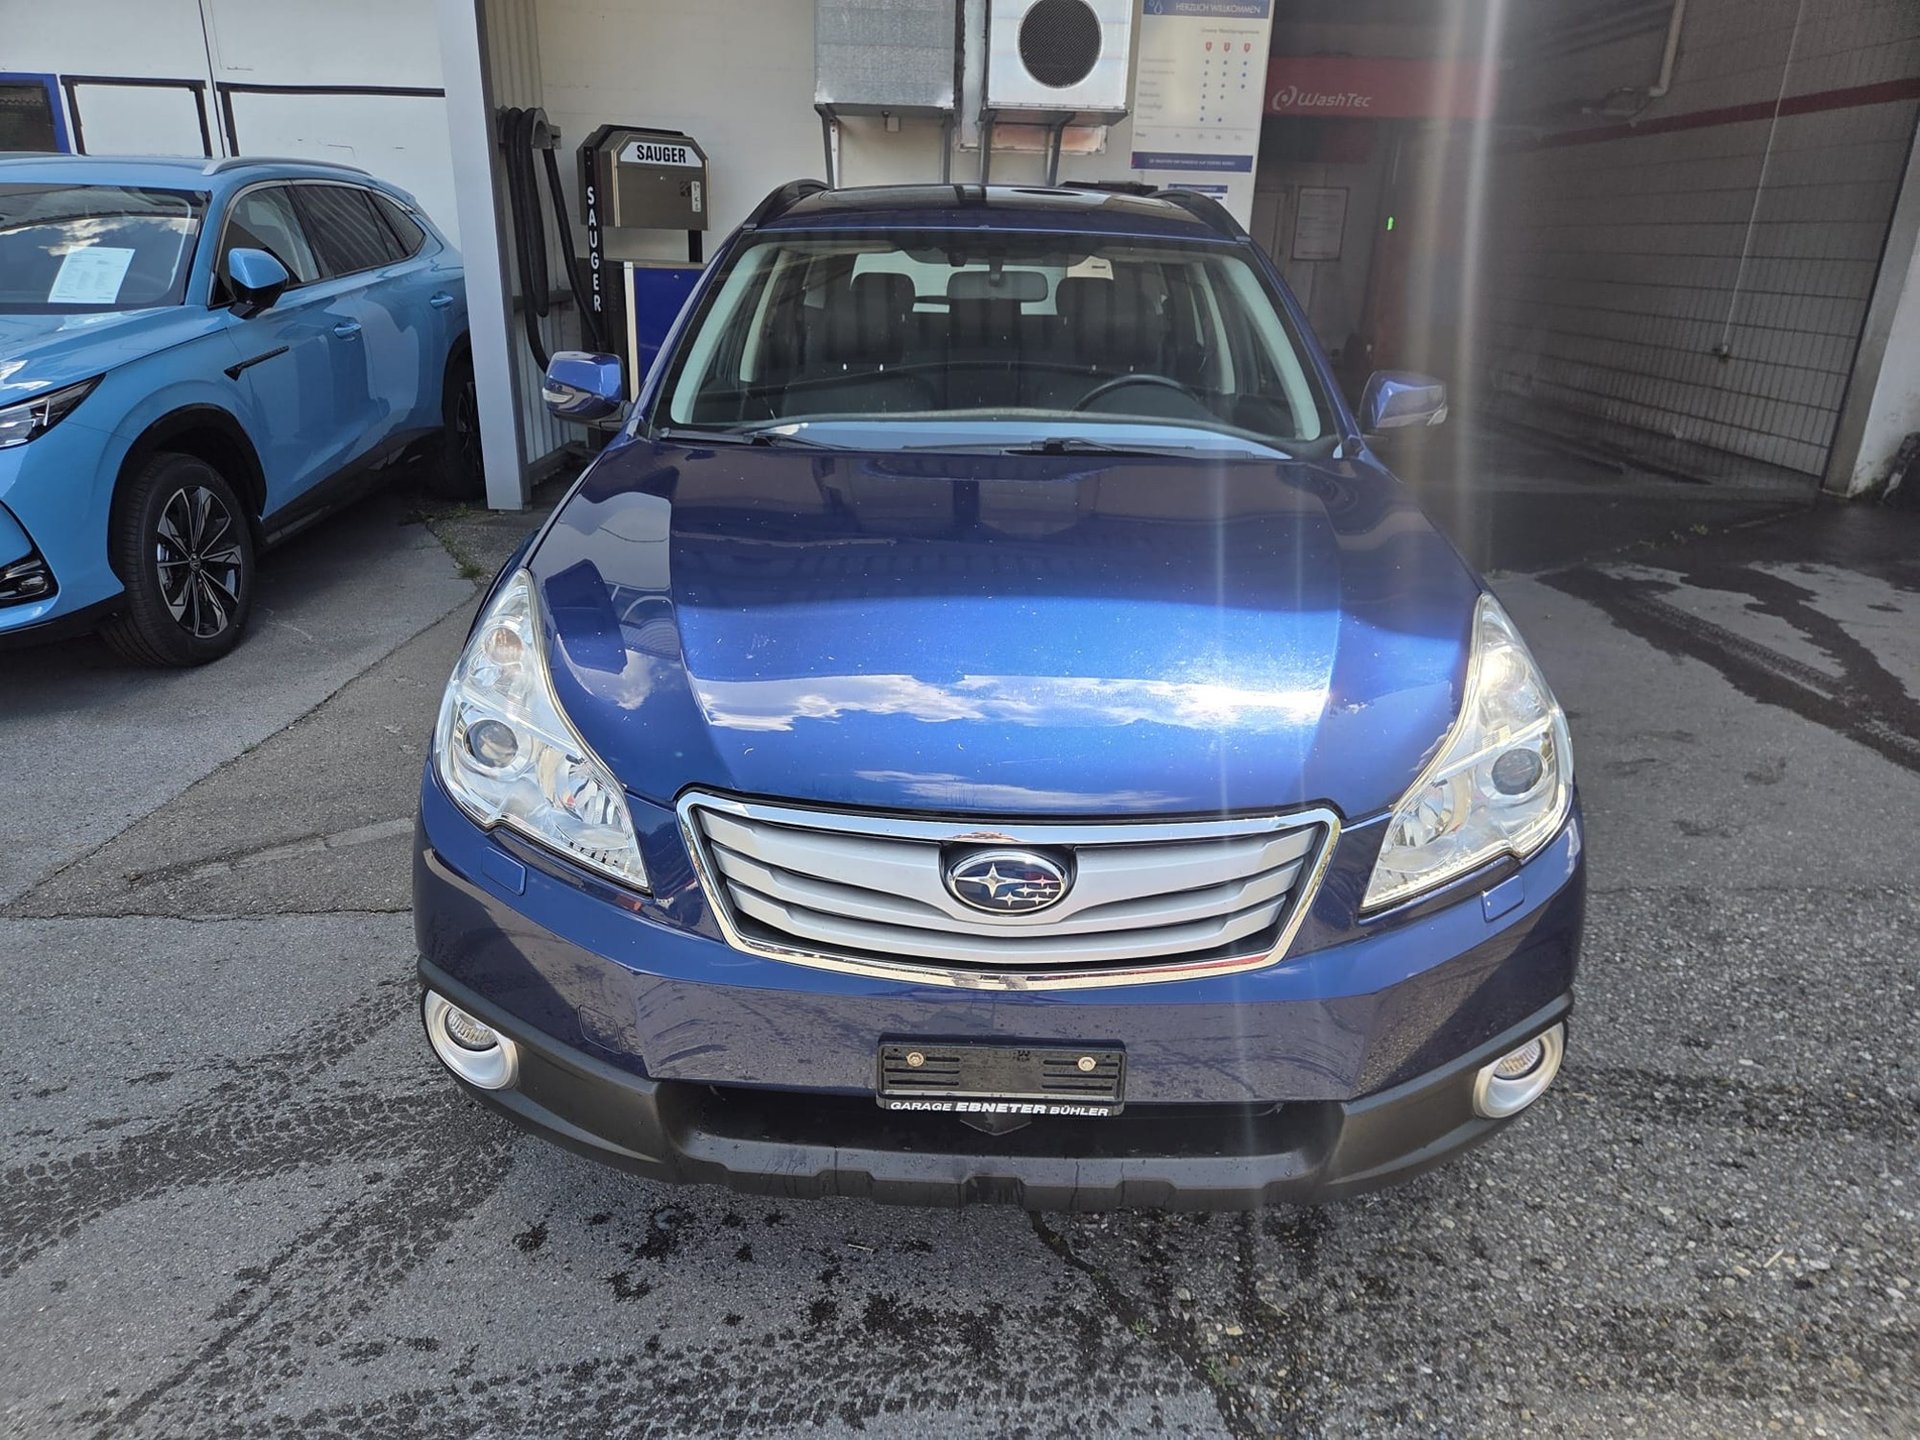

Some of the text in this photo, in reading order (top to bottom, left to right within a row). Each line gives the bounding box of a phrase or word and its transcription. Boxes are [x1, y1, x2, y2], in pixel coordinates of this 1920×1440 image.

[1175, 2, 1261, 14] HERZLICH WILLKOMMEN
[1297, 92, 1373, 108] WashTec
[636, 144, 687, 164] SAUGER
[586, 185, 602, 312] SAUGER
[890, 1101, 1109, 1117] GARAGE EBNETER BÜHLER
